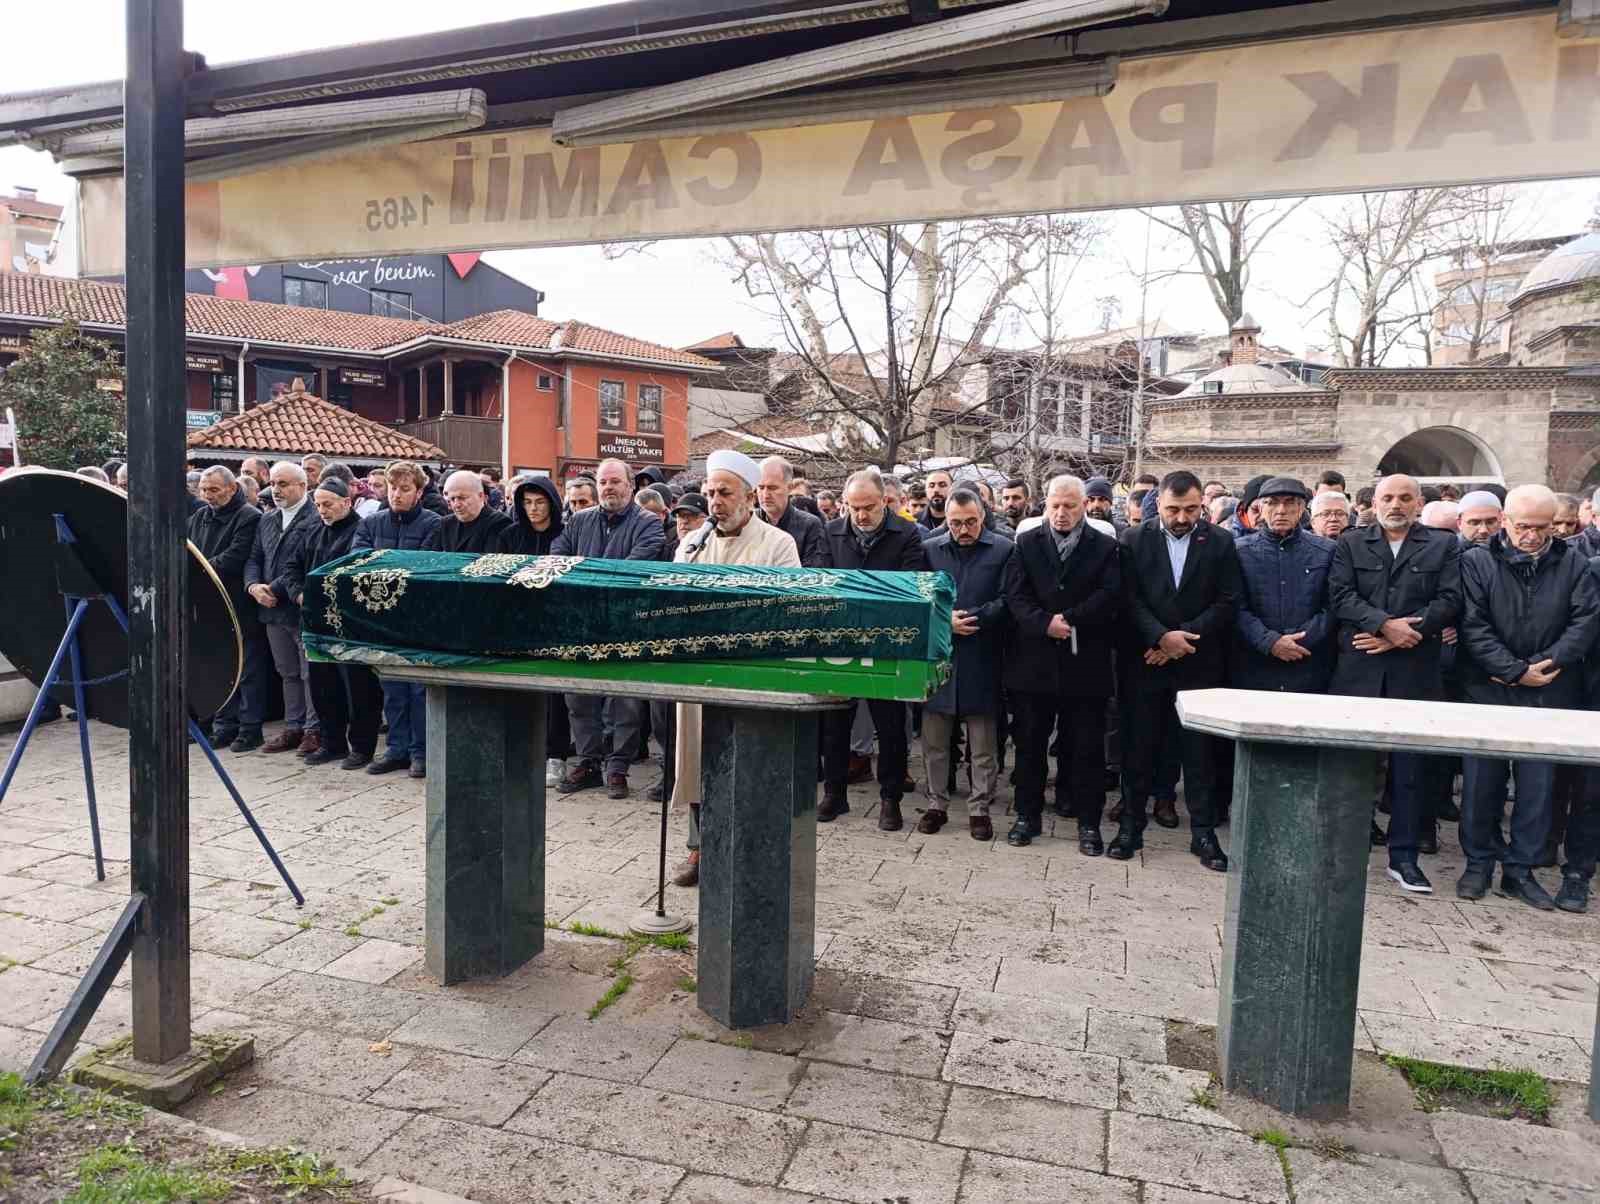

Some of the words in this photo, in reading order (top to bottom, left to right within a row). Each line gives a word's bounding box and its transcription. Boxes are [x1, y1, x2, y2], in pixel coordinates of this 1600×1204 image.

[332, 269, 369, 286] var
[375, 258, 436, 284] benim.
[615, 436, 649, 448] İNEGÖL
[600, 444, 634, 455] KÜLTÜR
[638, 448, 663, 457] VAKFI
[651, 608, 664, 617] can
